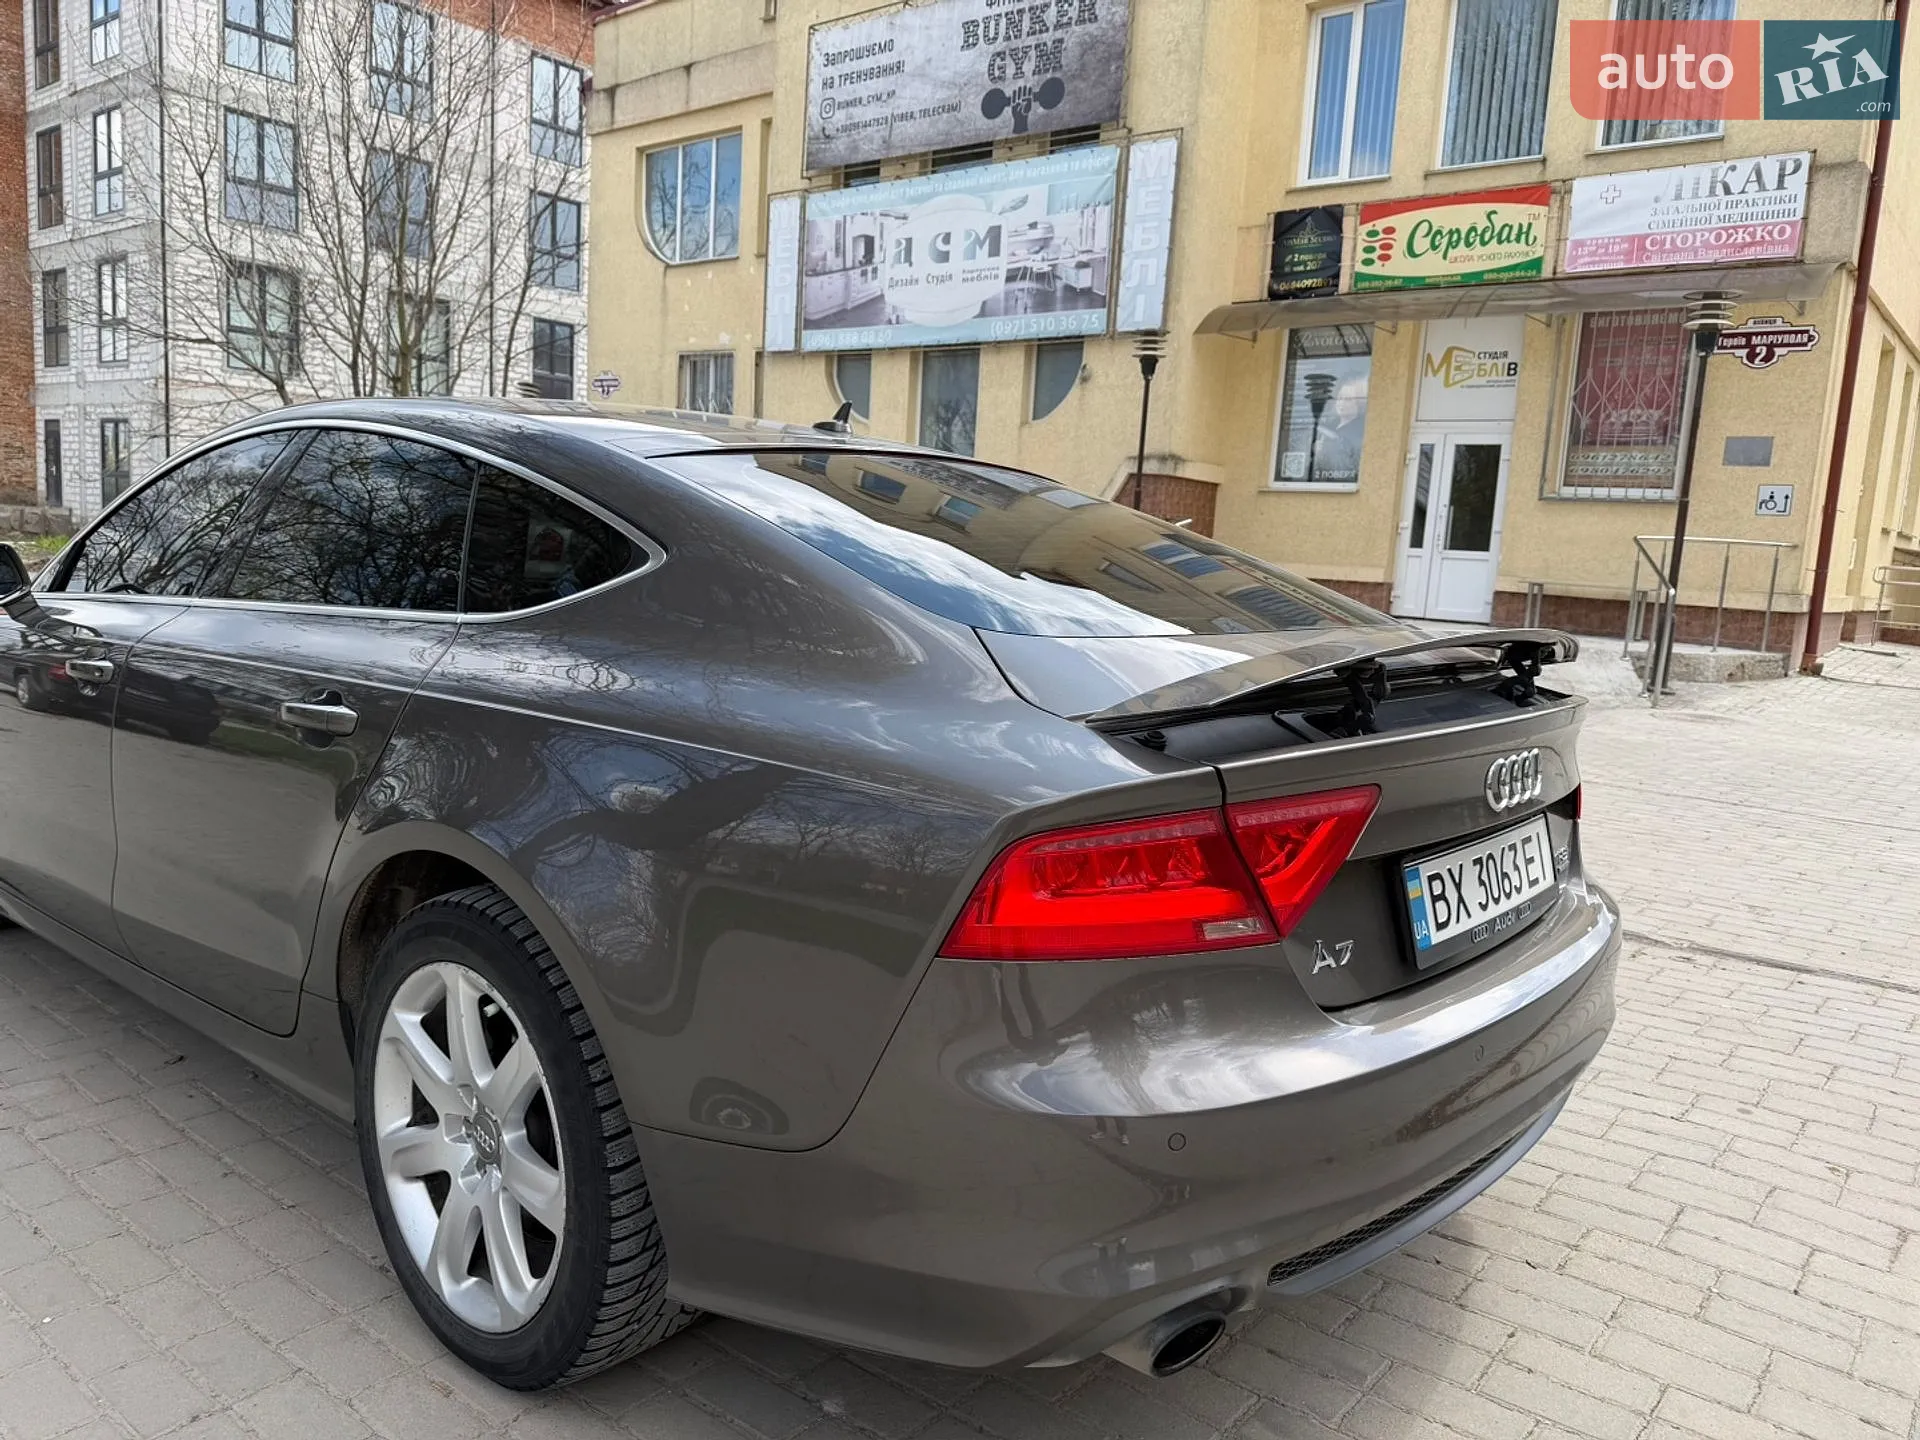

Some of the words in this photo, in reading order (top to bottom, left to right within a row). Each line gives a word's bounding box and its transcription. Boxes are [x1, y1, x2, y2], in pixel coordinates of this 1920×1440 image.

[960, 0, 1099, 51] BUNKER
[987, 37, 1065, 84] GYM
[1653, 157, 1803, 204] ЛІКАР
[1725, 193, 1798, 211] ПРАКТИКИ
[1715, 207, 1798, 227] МЕДИЦИНИ
[1403, 209, 1538, 261] Соробан
[1644, 223, 1793, 251] СТОРОЖКО
[1029, 318, 1055, 332] 510
[1082, 314, 1099, 328] 75
[1751, 333, 1809, 345] МАРІУПОЛЯ
[1477, 350, 1509, 360] СТУДІЯ
[1754, 346, 1768, 365] 2
[1426, 862, 1473, 932] BX
[1472, 841, 1524, 912] 3063
[1523, 830, 1547, 889] EI
[1414, 919, 1430, 940] UA
[1494, 910, 1516, 933] Audi
[1311, 939, 1355, 975] A7
